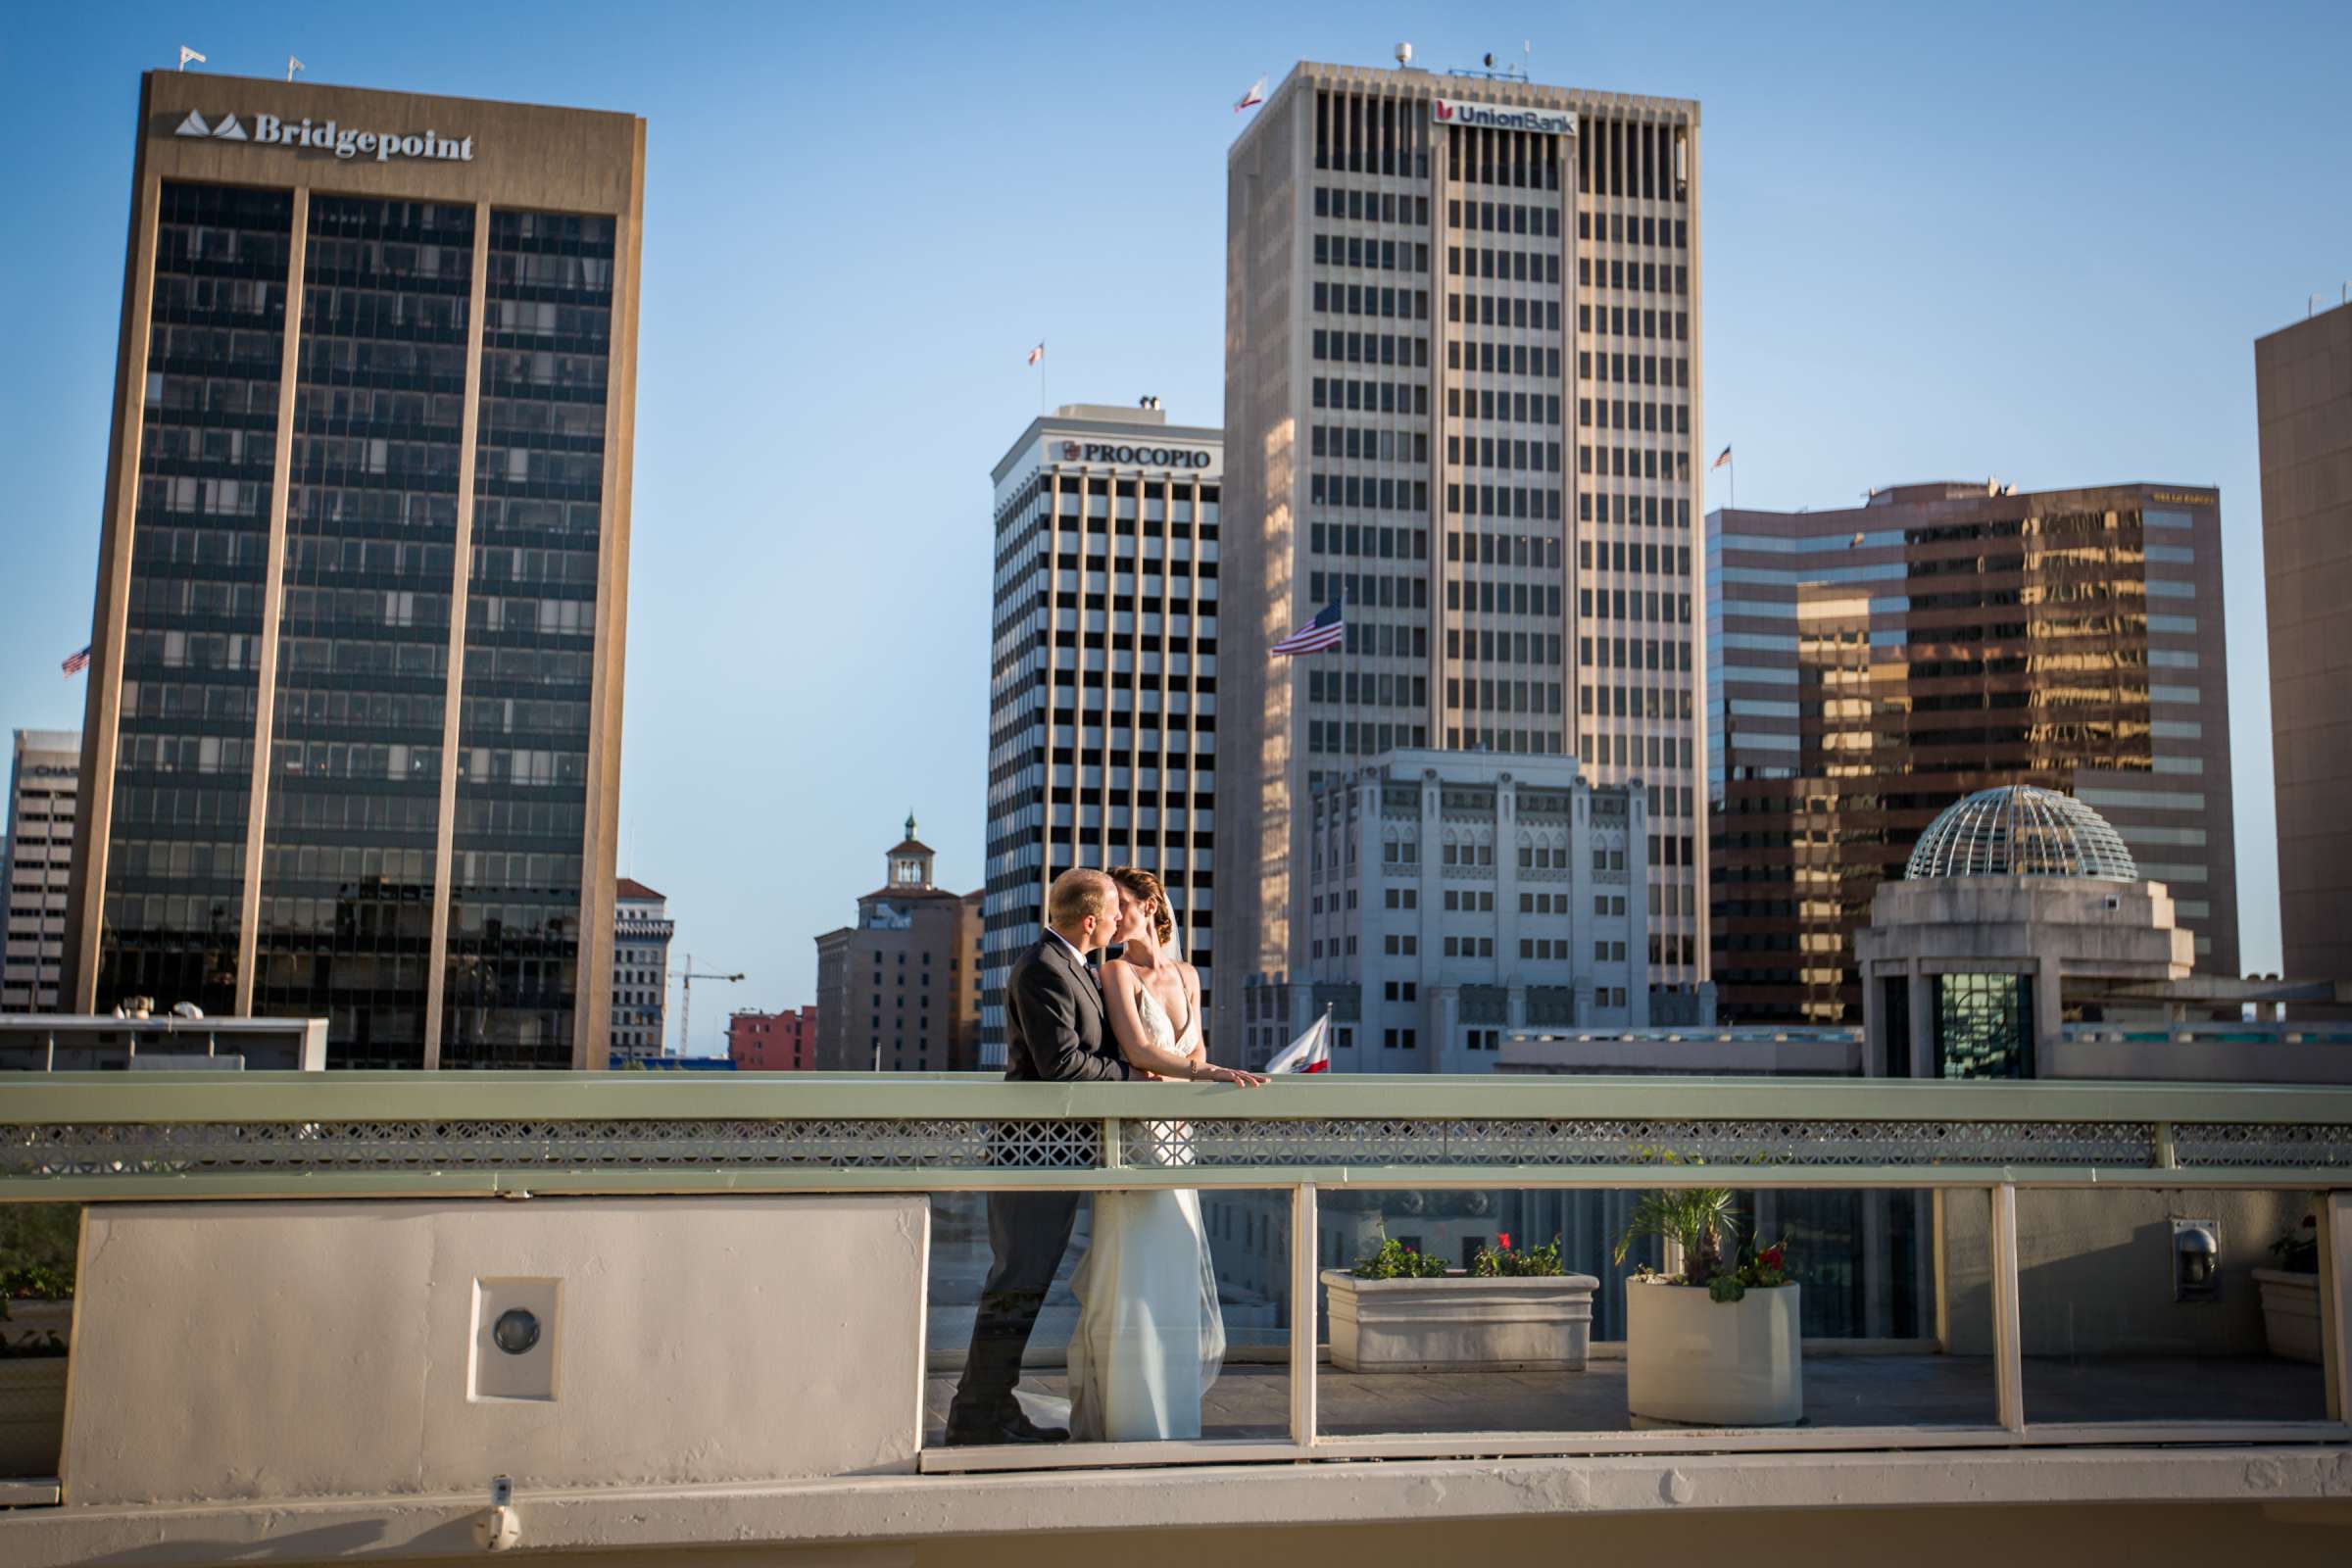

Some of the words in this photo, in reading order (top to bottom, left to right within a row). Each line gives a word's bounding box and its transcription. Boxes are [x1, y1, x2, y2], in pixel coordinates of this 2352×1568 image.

[1459, 105, 1574, 133] UnionBank
[254, 114, 474, 162] Bridgepoint
[1084, 443, 1211, 468] PROCOPIO
